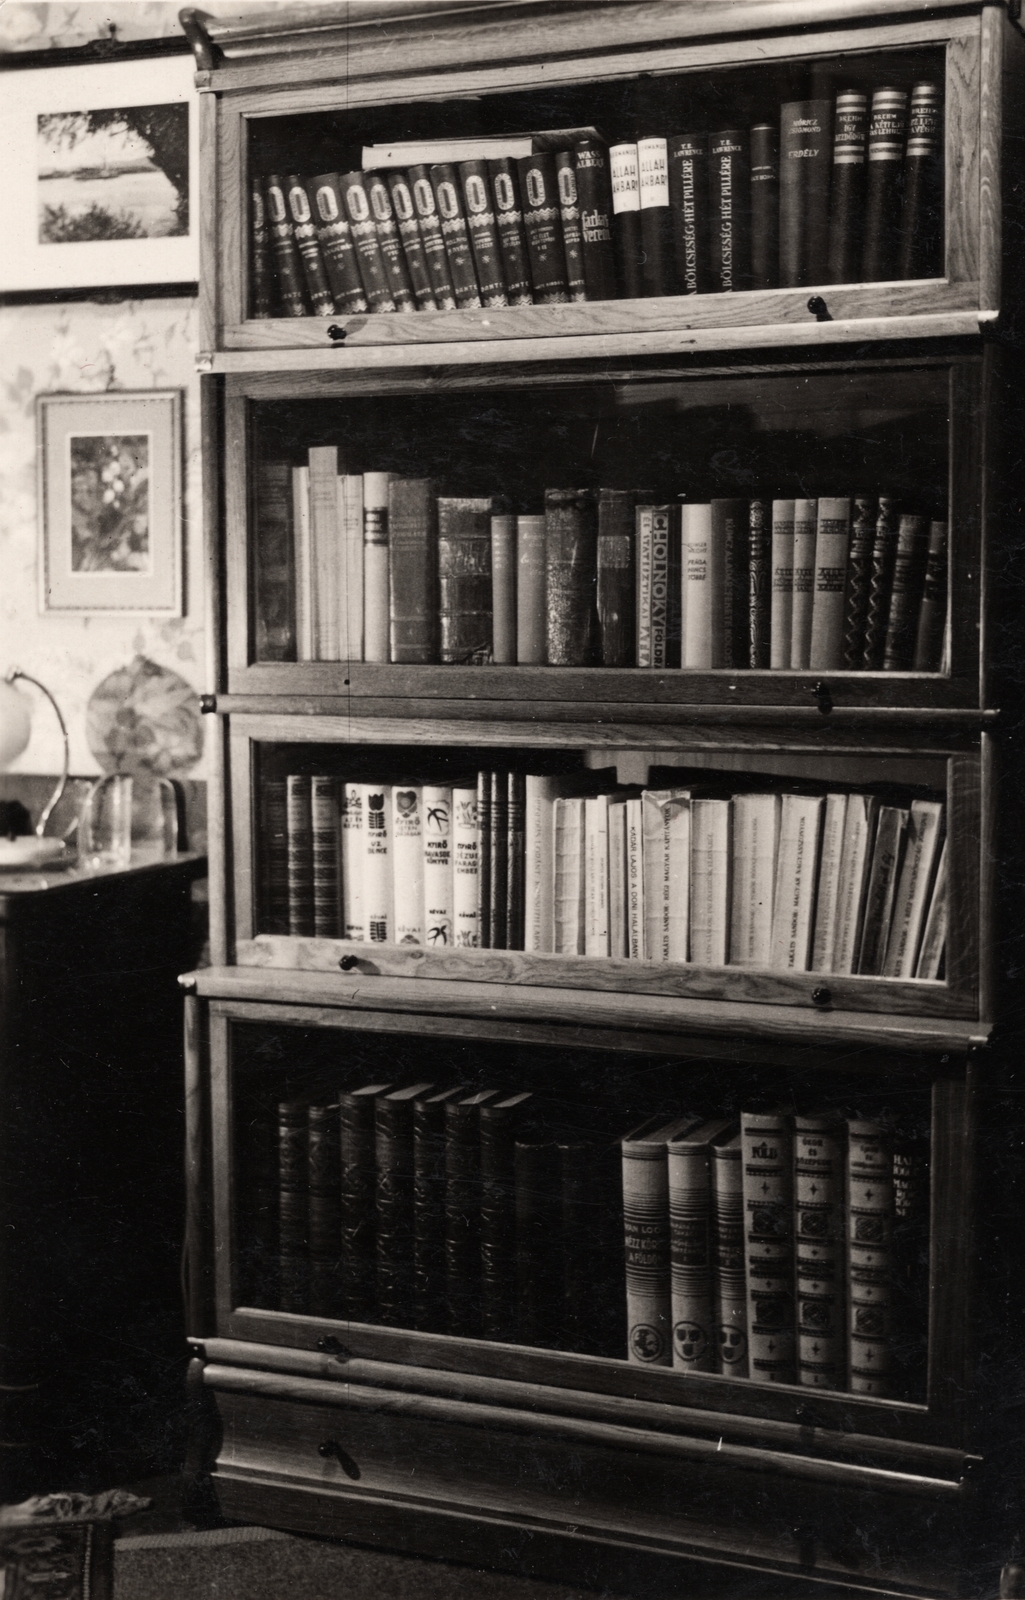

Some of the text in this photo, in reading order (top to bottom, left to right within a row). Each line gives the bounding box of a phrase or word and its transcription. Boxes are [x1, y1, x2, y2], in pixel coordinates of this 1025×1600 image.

[577, 150, 600, 159] WASS
[674, 148, 703, 158] LAWRENCE
[712, 145, 742, 154] LAWRENCE
[788, 147, 819, 158] ERDÉLY
[612, 164, 636, 178] ALLAH
[641, 159, 665, 172] ALLAH
[681, 159, 697, 289] BÖLCSESÉG HÉT PILLÉRE
[719, 155, 733, 287] BÖLCSESÉG HÉT PILLÉRE
[455, 283, 478, 295] DANTE
[481, 282, 504, 293] DANTE
[651, 514, 669, 627] CHOLNOKY
[367, 830, 388, 838] NYIRŐ
[427, 839, 448, 849] NYIRŐ
[457, 842, 477, 851] NYIRŐ
[793, 876, 801, 907] MAGYAR
[662, 935, 670, 961] TAKÁTS
